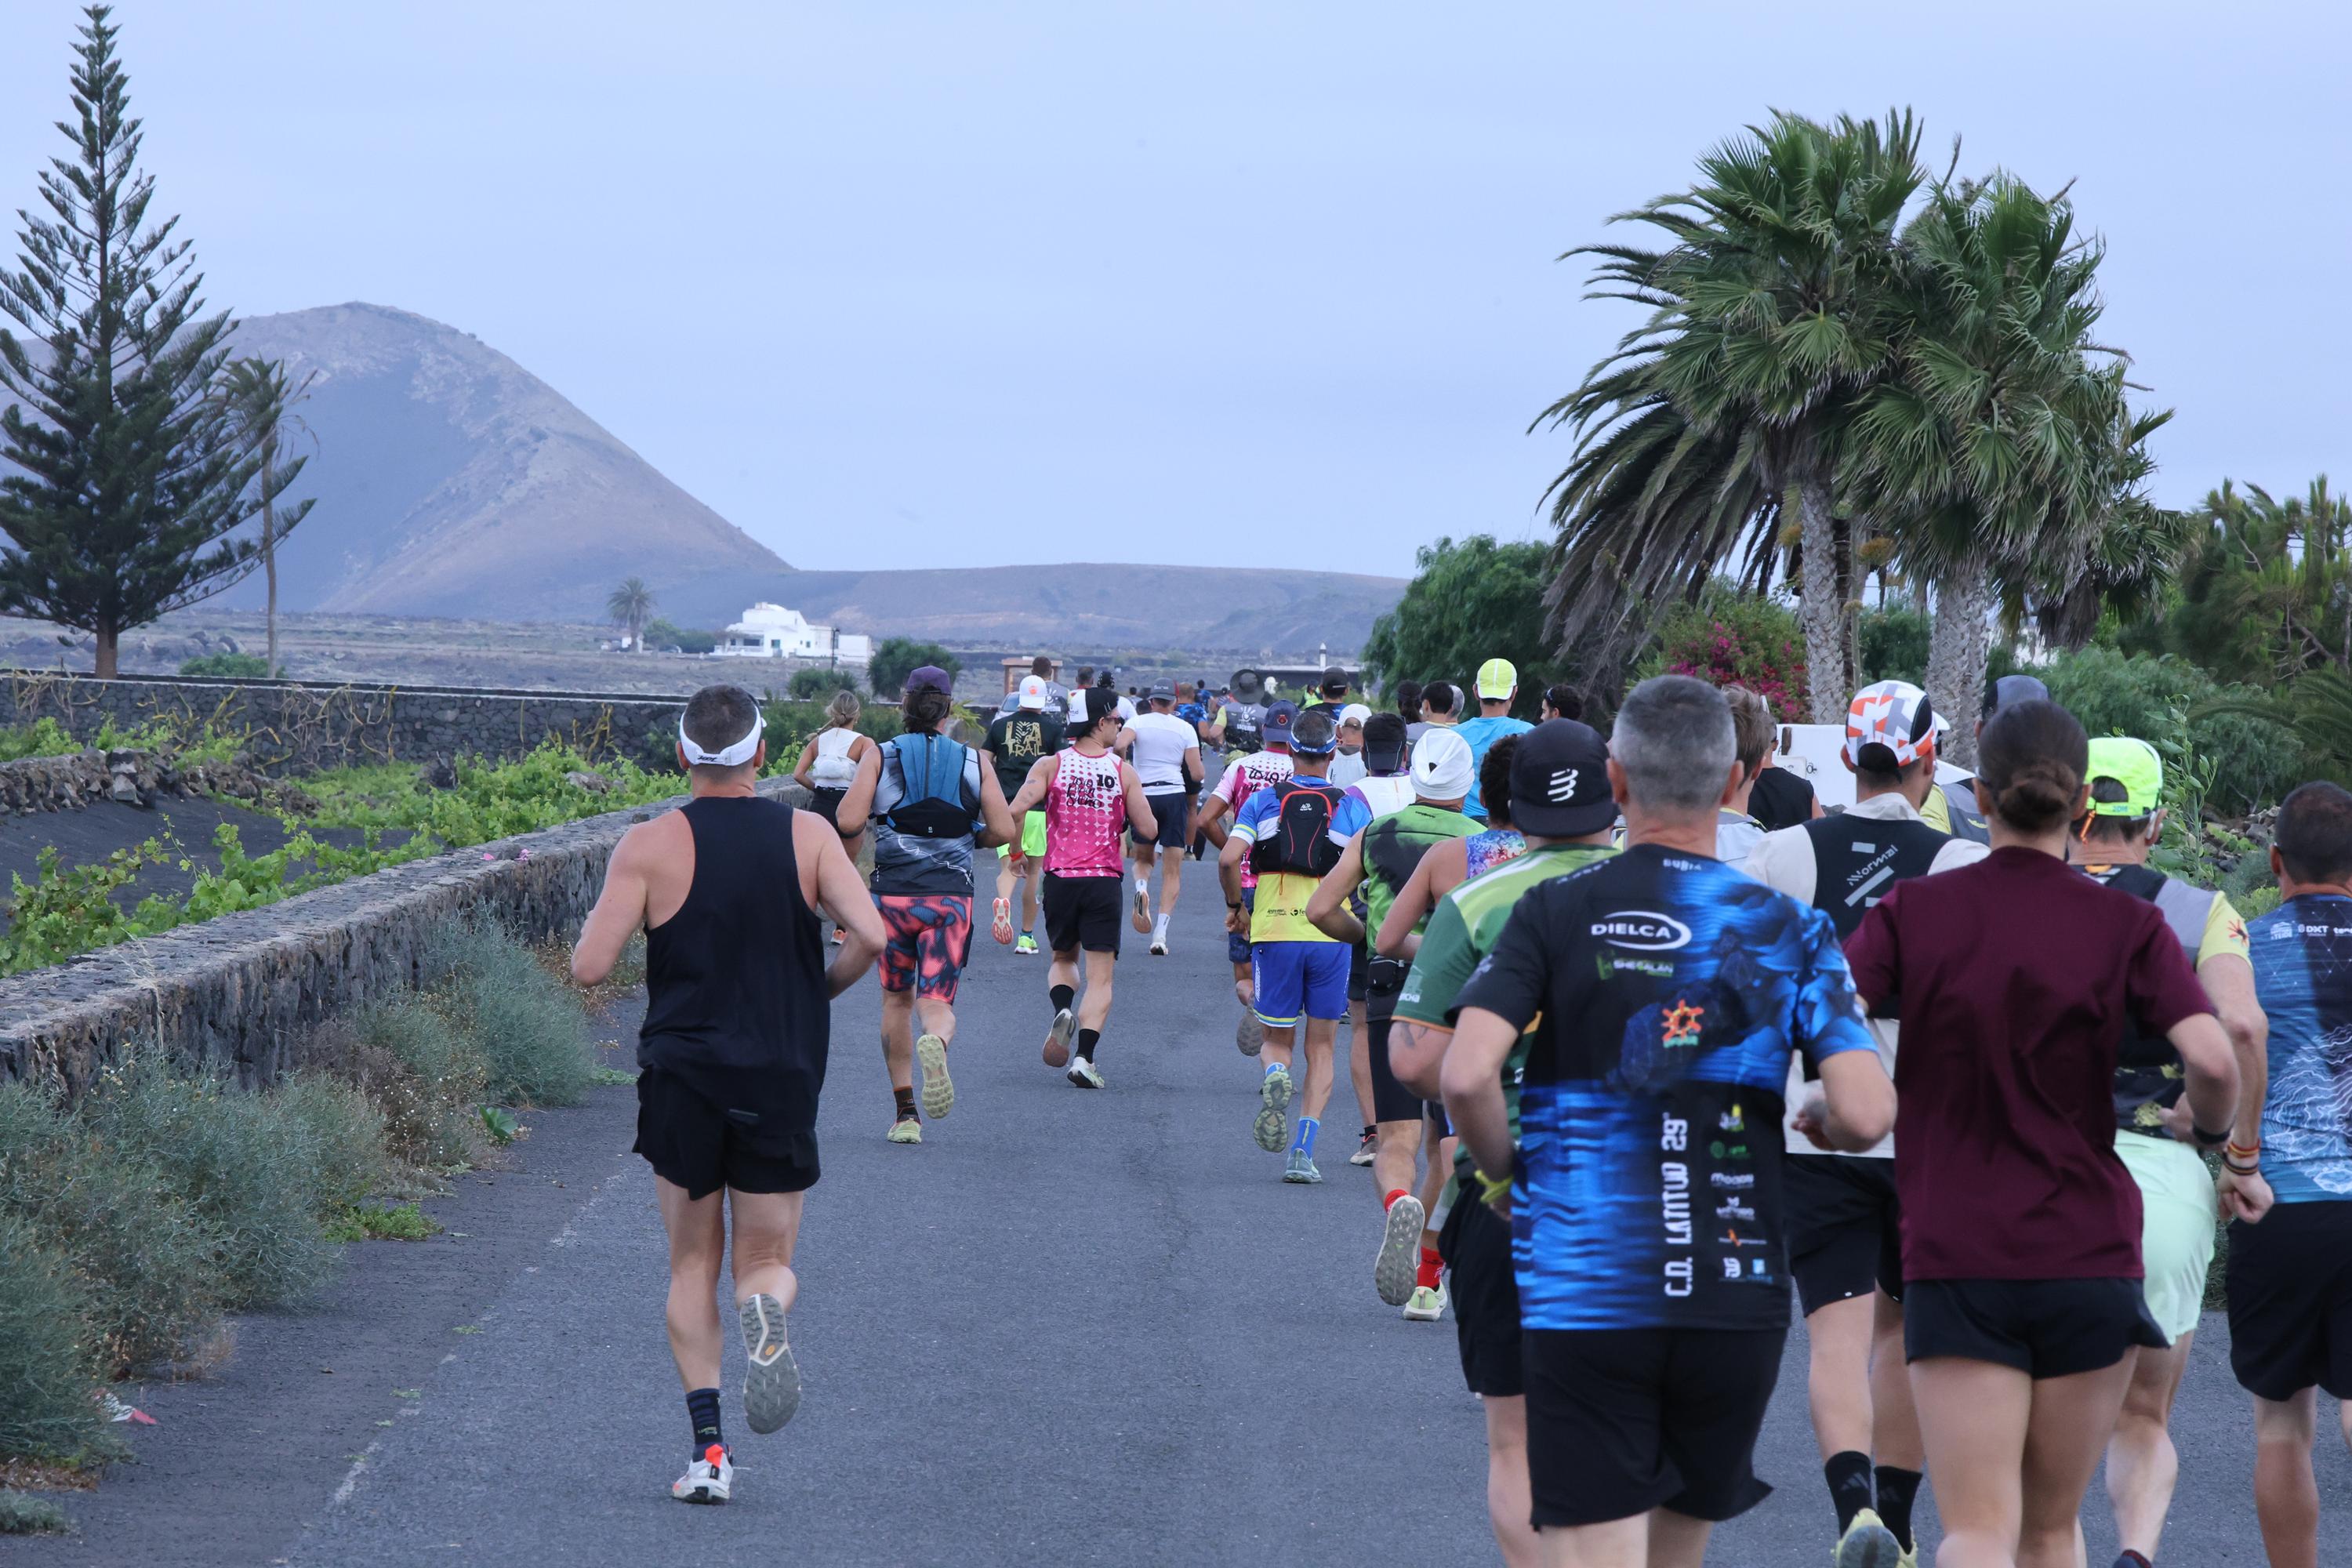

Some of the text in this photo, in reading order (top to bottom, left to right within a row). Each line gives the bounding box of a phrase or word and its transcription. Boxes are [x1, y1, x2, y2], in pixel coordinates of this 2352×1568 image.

[1096, 774, 1116, 789] 10
[1591, 923, 1671, 939] DIELCA
[2306, 925, 2329, 934] DXT
[1661, 1162, 1692, 1244] LATITUD
[1664, 1257, 1693, 1297] C.D.
